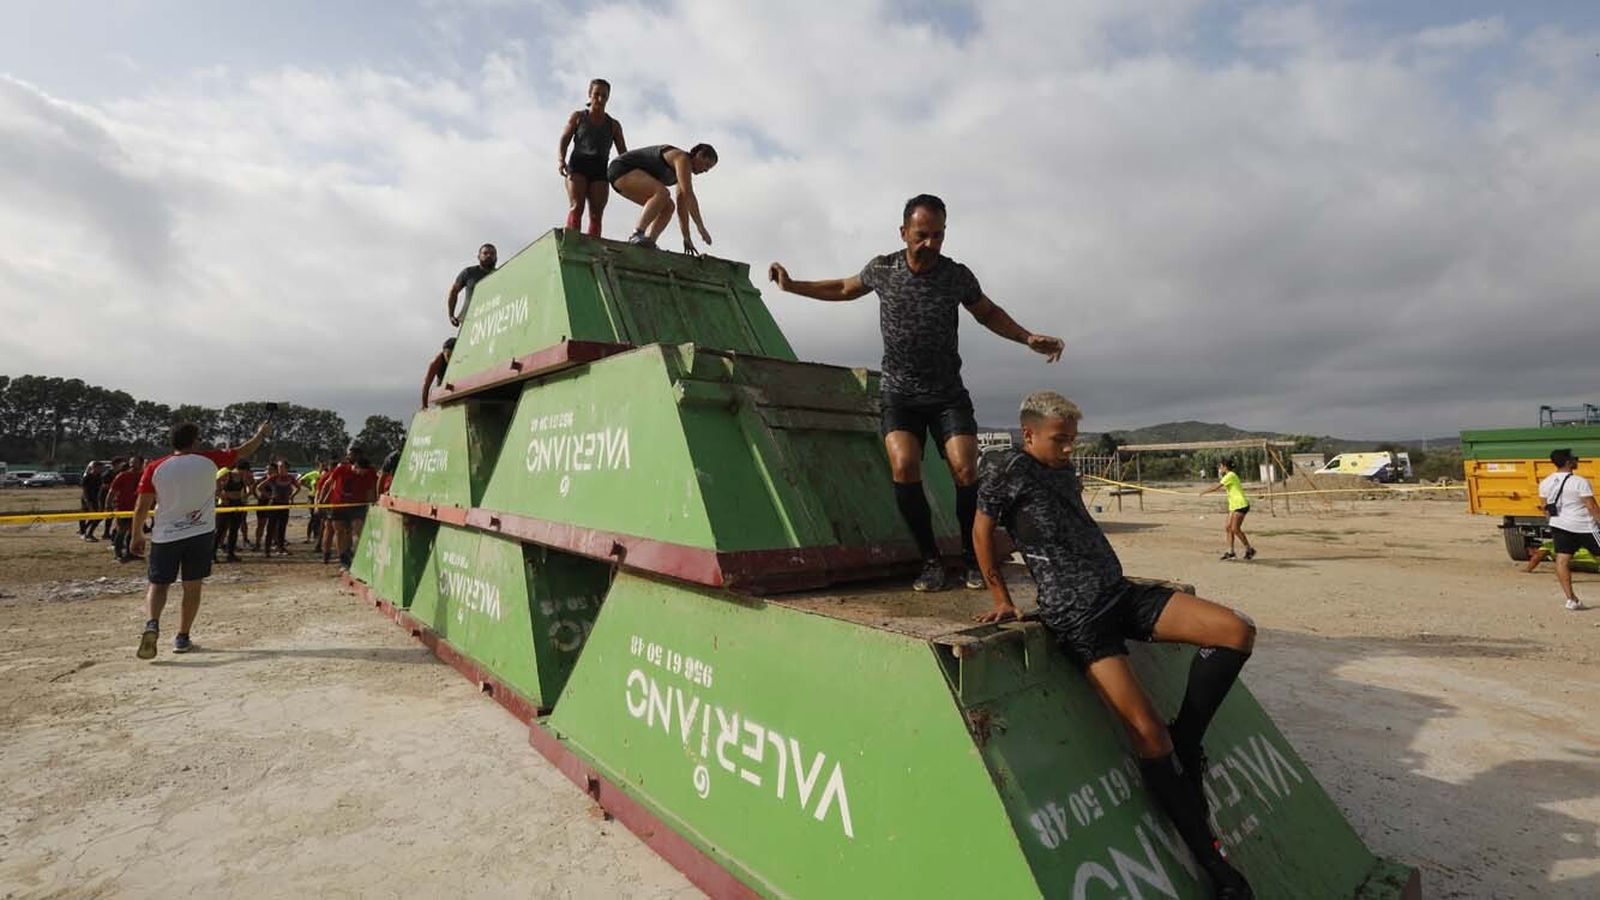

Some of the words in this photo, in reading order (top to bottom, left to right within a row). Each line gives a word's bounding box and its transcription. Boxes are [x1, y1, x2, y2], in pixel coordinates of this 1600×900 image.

[526, 427, 630, 472] VALERIANO
[631, 635, 645, 657] 48
[647, 642, 662, 665] 50
[666, 649, 682, 675] 61
[626, 668, 854, 839] VALERIANO
[1029, 802, 1070, 850] 48
[1069, 784, 1105, 827] 50
